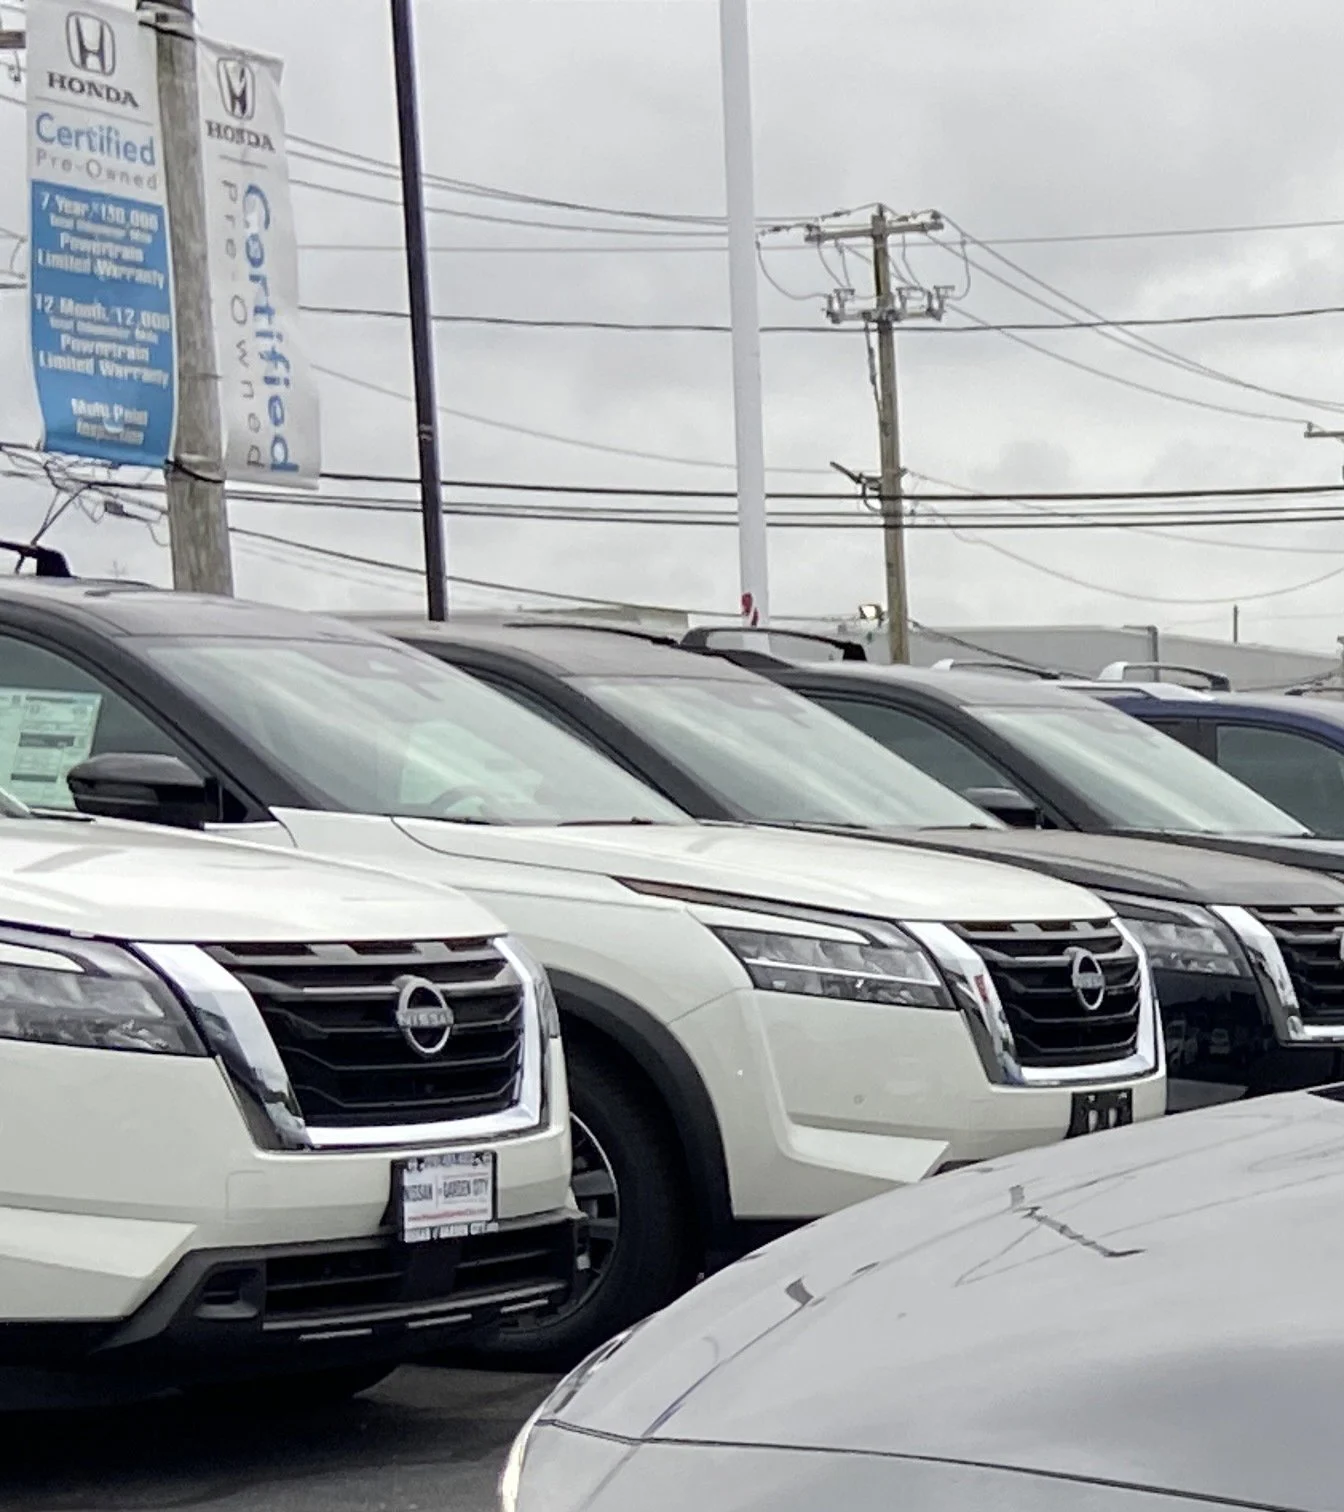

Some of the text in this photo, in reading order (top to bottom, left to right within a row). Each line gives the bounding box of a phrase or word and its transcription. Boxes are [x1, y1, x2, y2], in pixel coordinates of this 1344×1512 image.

[47, 71, 139, 108] HONDA
[35, 112, 156, 166] Certified
[205, 119, 276, 152] HONDA
[36, 147, 158, 190] Pre-Owned
[243, 183, 299, 473] Certified
